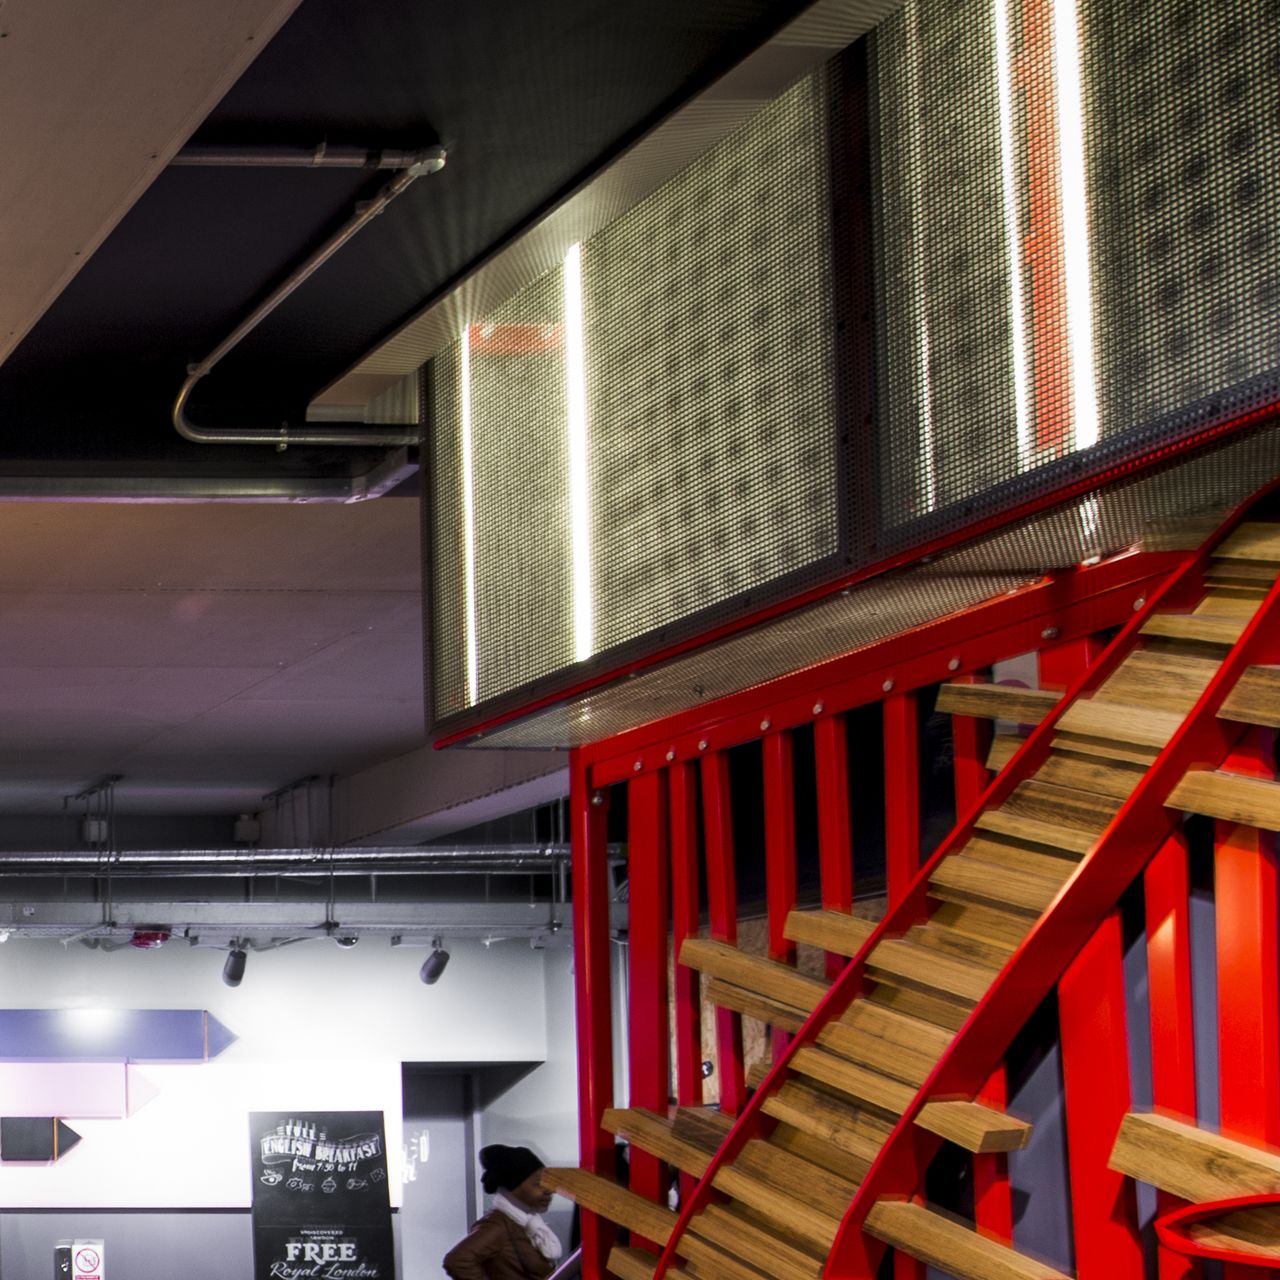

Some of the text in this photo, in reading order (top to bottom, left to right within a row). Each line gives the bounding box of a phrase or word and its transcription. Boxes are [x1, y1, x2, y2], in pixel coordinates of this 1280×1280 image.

[263, 1139, 378, 1163] ENGLISH BREAKFAST
[285, 1242, 357, 1265] FREE
[270, 1261, 379, 1280] Royal London
